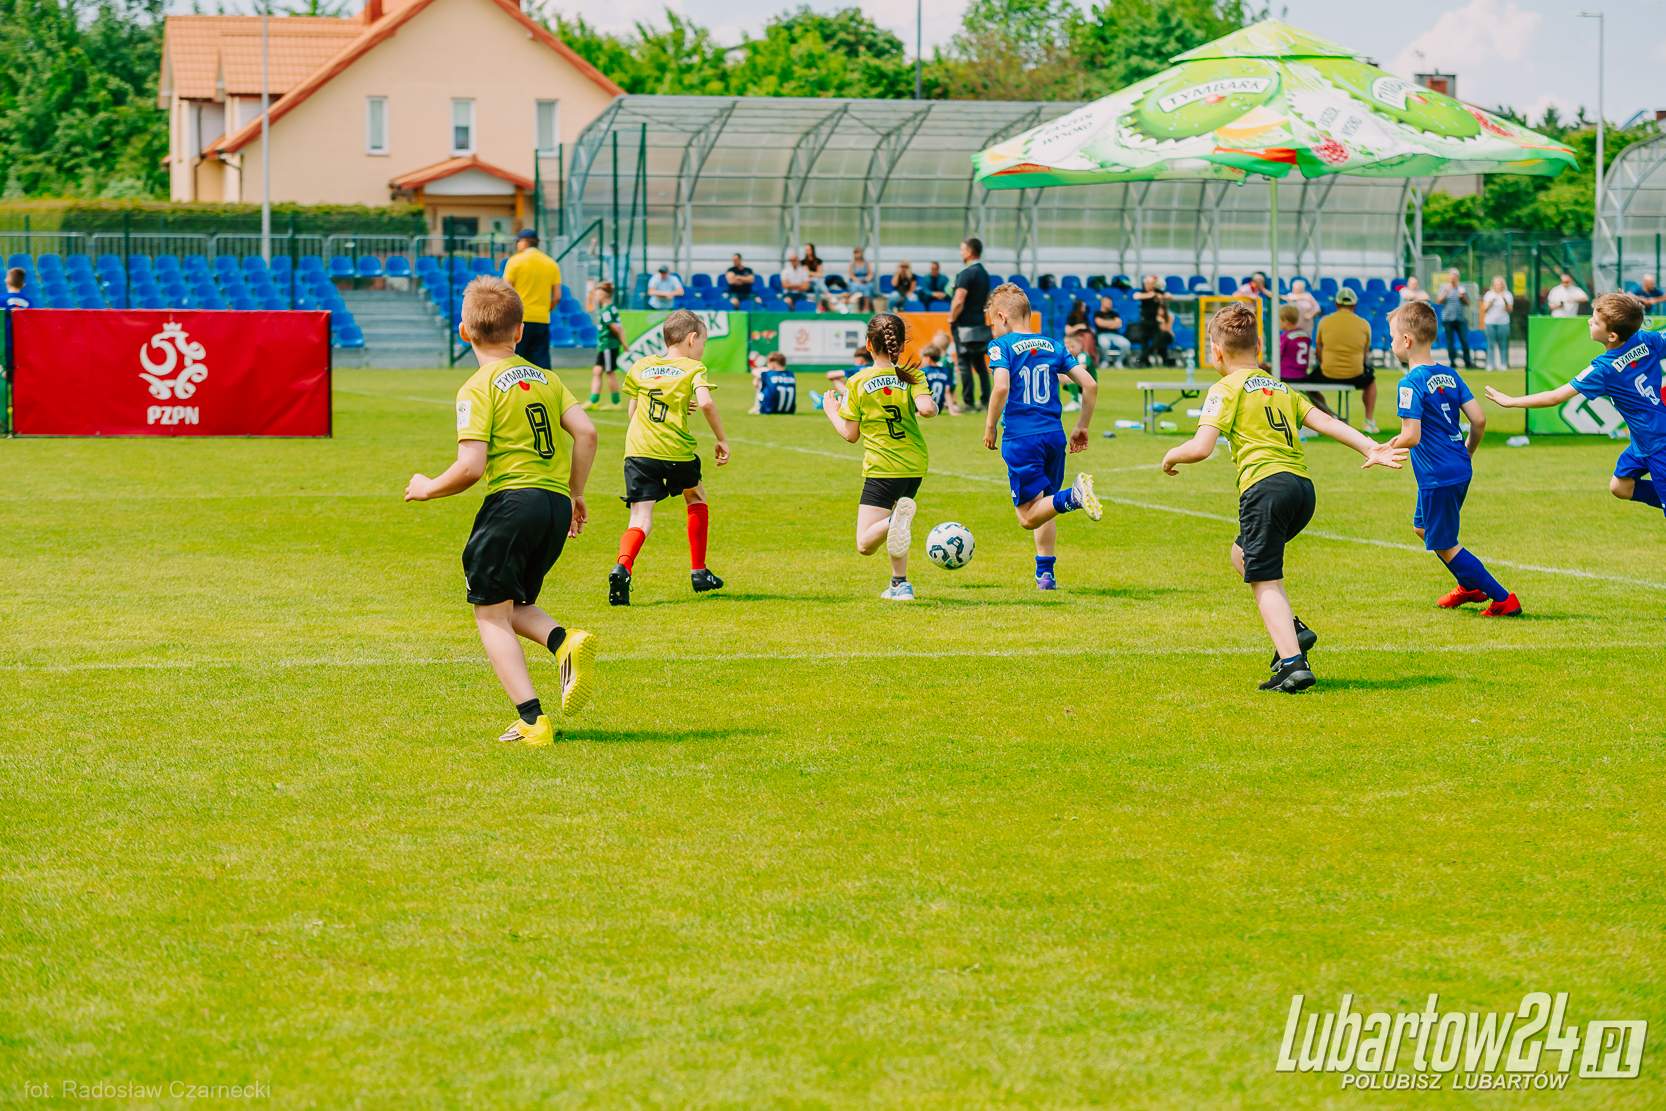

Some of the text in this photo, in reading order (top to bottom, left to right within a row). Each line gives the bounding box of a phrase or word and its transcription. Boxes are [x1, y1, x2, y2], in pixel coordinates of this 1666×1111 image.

[1296, 341, 1308, 365] 2
[1615, 345, 1649, 370] TYMBARK
[497, 368, 545, 388] TYMBARK
[1018, 363, 1051, 405] 10
[648, 388, 670, 423] 6
[776, 385, 794, 412] 11
[147, 405, 200, 425] PZPN
[882, 404, 906, 440] 2
[1264, 406, 1294, 448] 4
[525, 402, 555, 460] 8
